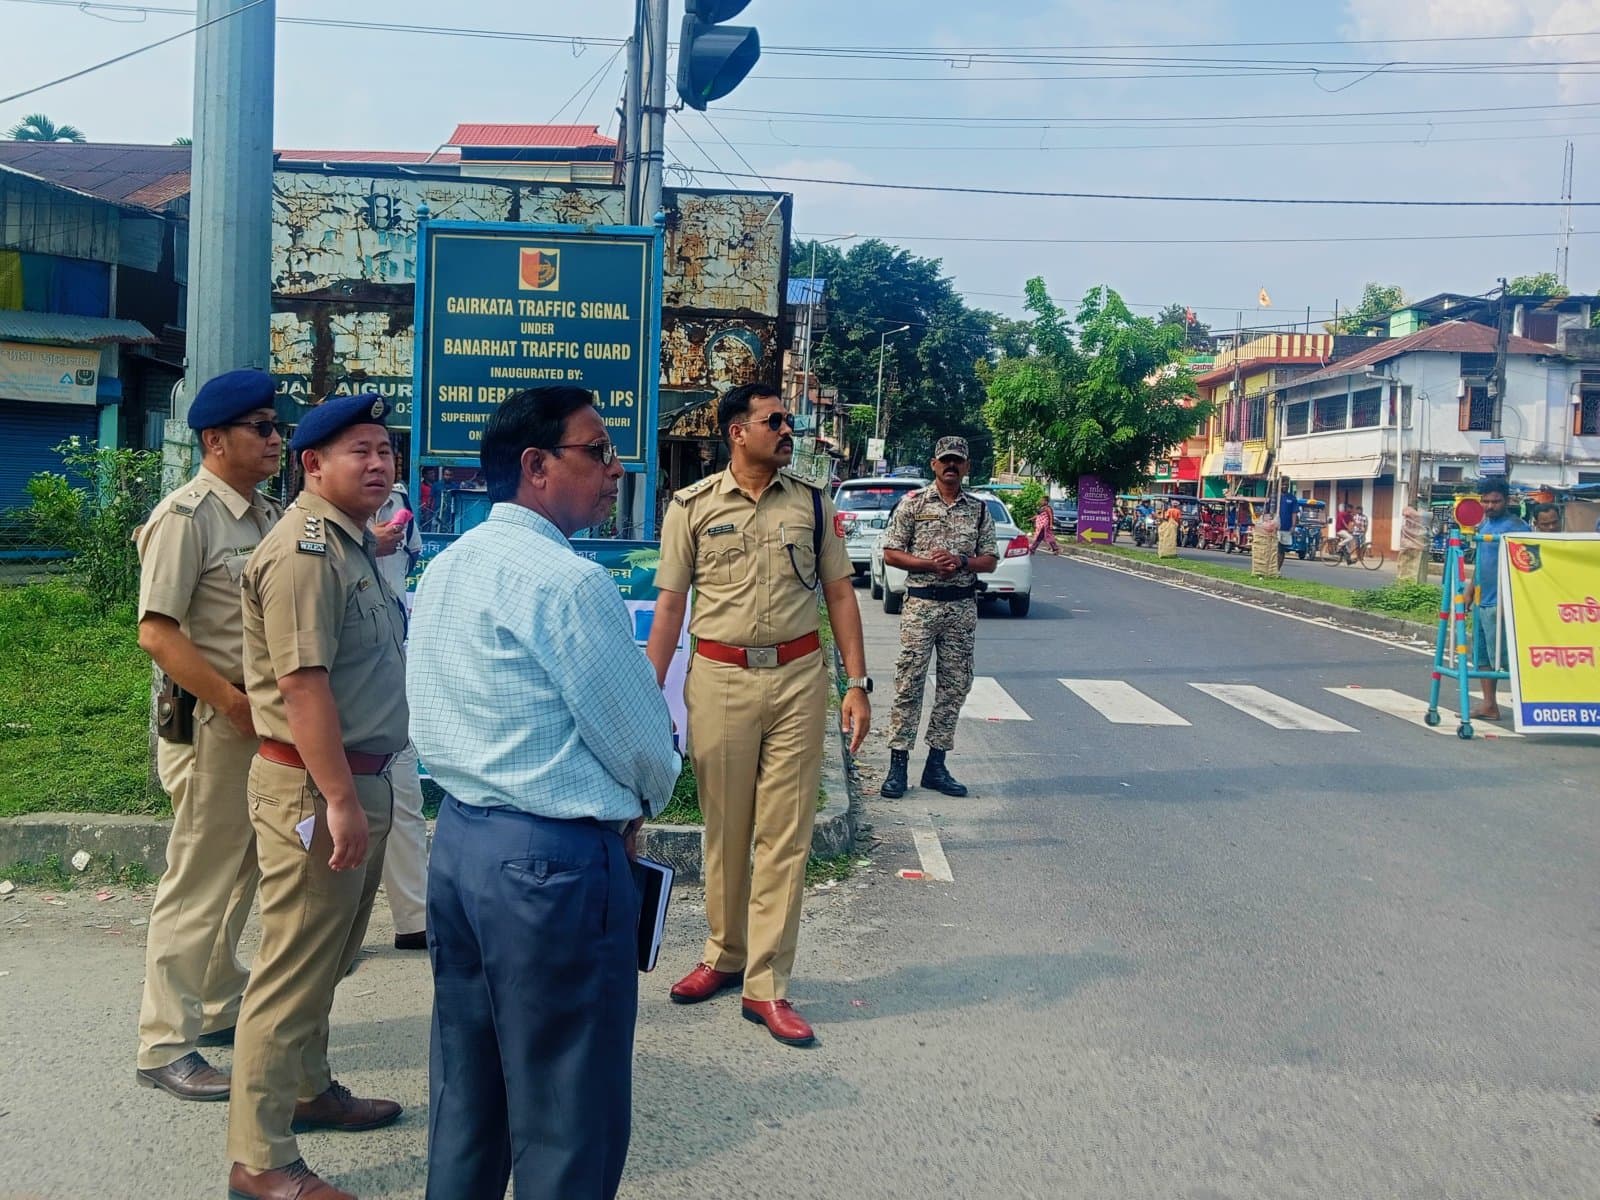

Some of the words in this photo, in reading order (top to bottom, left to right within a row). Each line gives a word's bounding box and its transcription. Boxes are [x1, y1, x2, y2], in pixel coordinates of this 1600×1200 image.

[447, 297, 514, 316] GAIRKATA
[518, 299, 576, 318] TRAFFIC
[580, 302, 630, 320] SIGNAL
[520, 322, 555, 335] UNDER
[444, 338, 518, 357] BANARHAT
[521, 341, 579, 359] TRAFFIC
[584, 343, 631, 360] GUARD
[490, 367, 564, 380] INAUGURATED
[567, 369, 584, 380] BY:
[438, 385, 473, 403] SHRI
[610, 390, 634, 408] IPS
[602, 417, 631, 428] IGURI
[1529, 646, 1595, 668] চলাচল
[1533, 709, 1577, 723] ORDER
